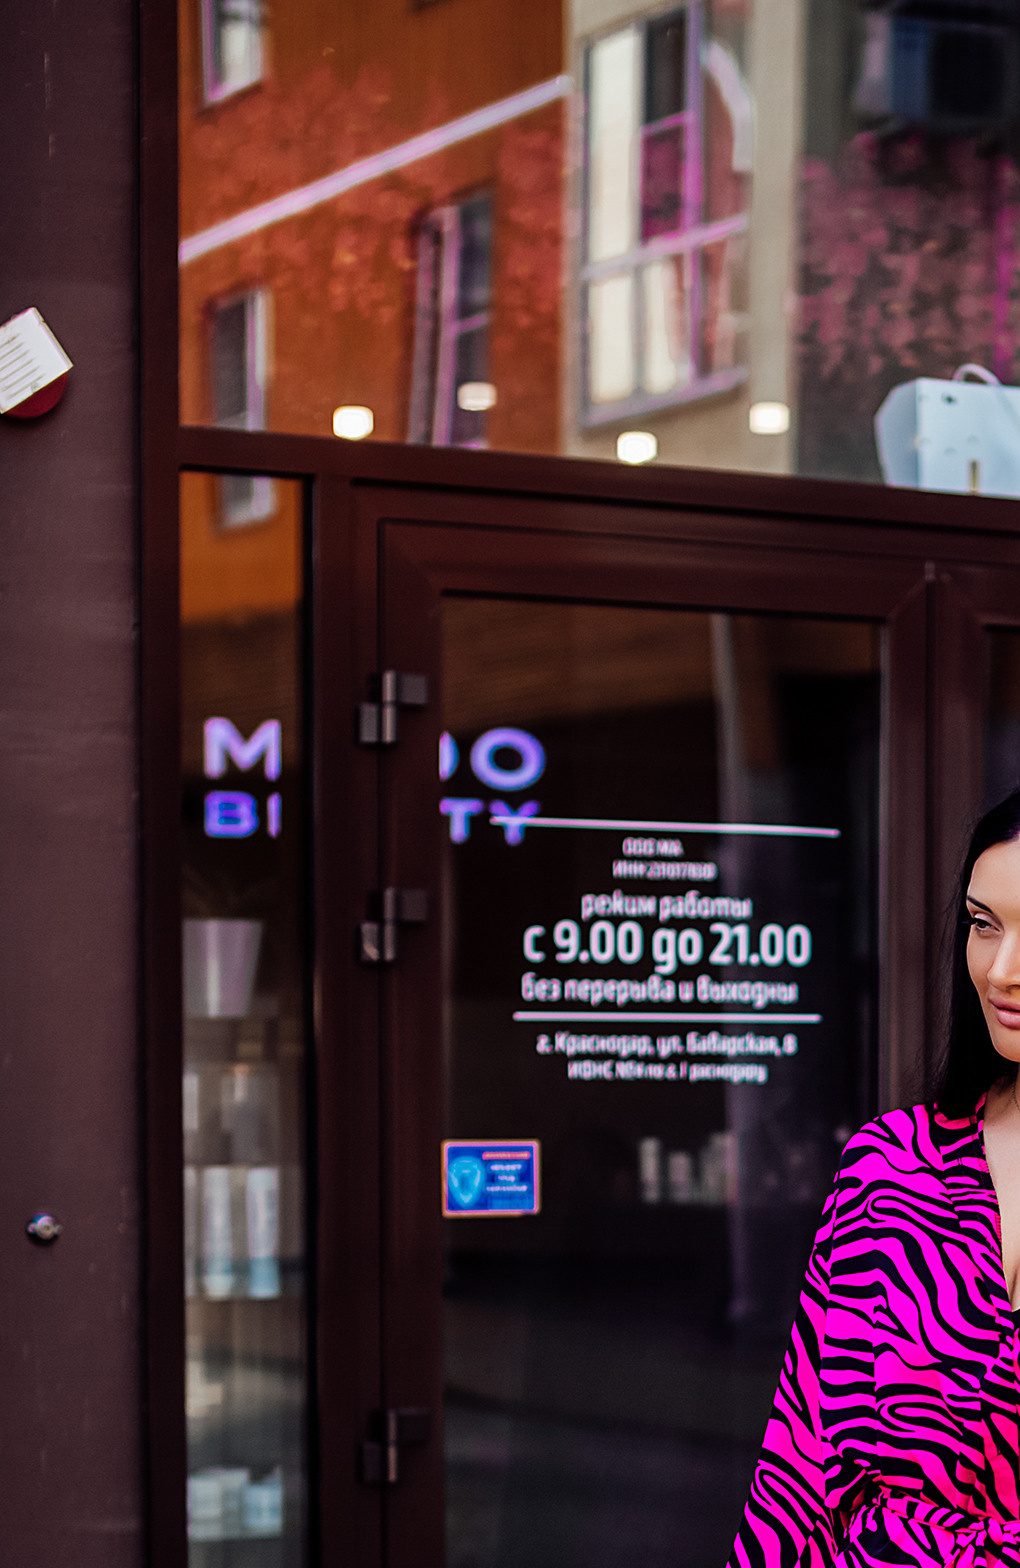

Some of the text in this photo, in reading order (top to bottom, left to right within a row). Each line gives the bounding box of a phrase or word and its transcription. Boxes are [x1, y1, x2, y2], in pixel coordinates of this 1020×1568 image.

[581, 889, 753, 922] режим работы
[523, 919, 813, 975] с 9.00 до 21.00
[521, 971, 562, 1001] без
[564, 973, 677, 1008] перерыва
[678, 980, 694, 1002] и
